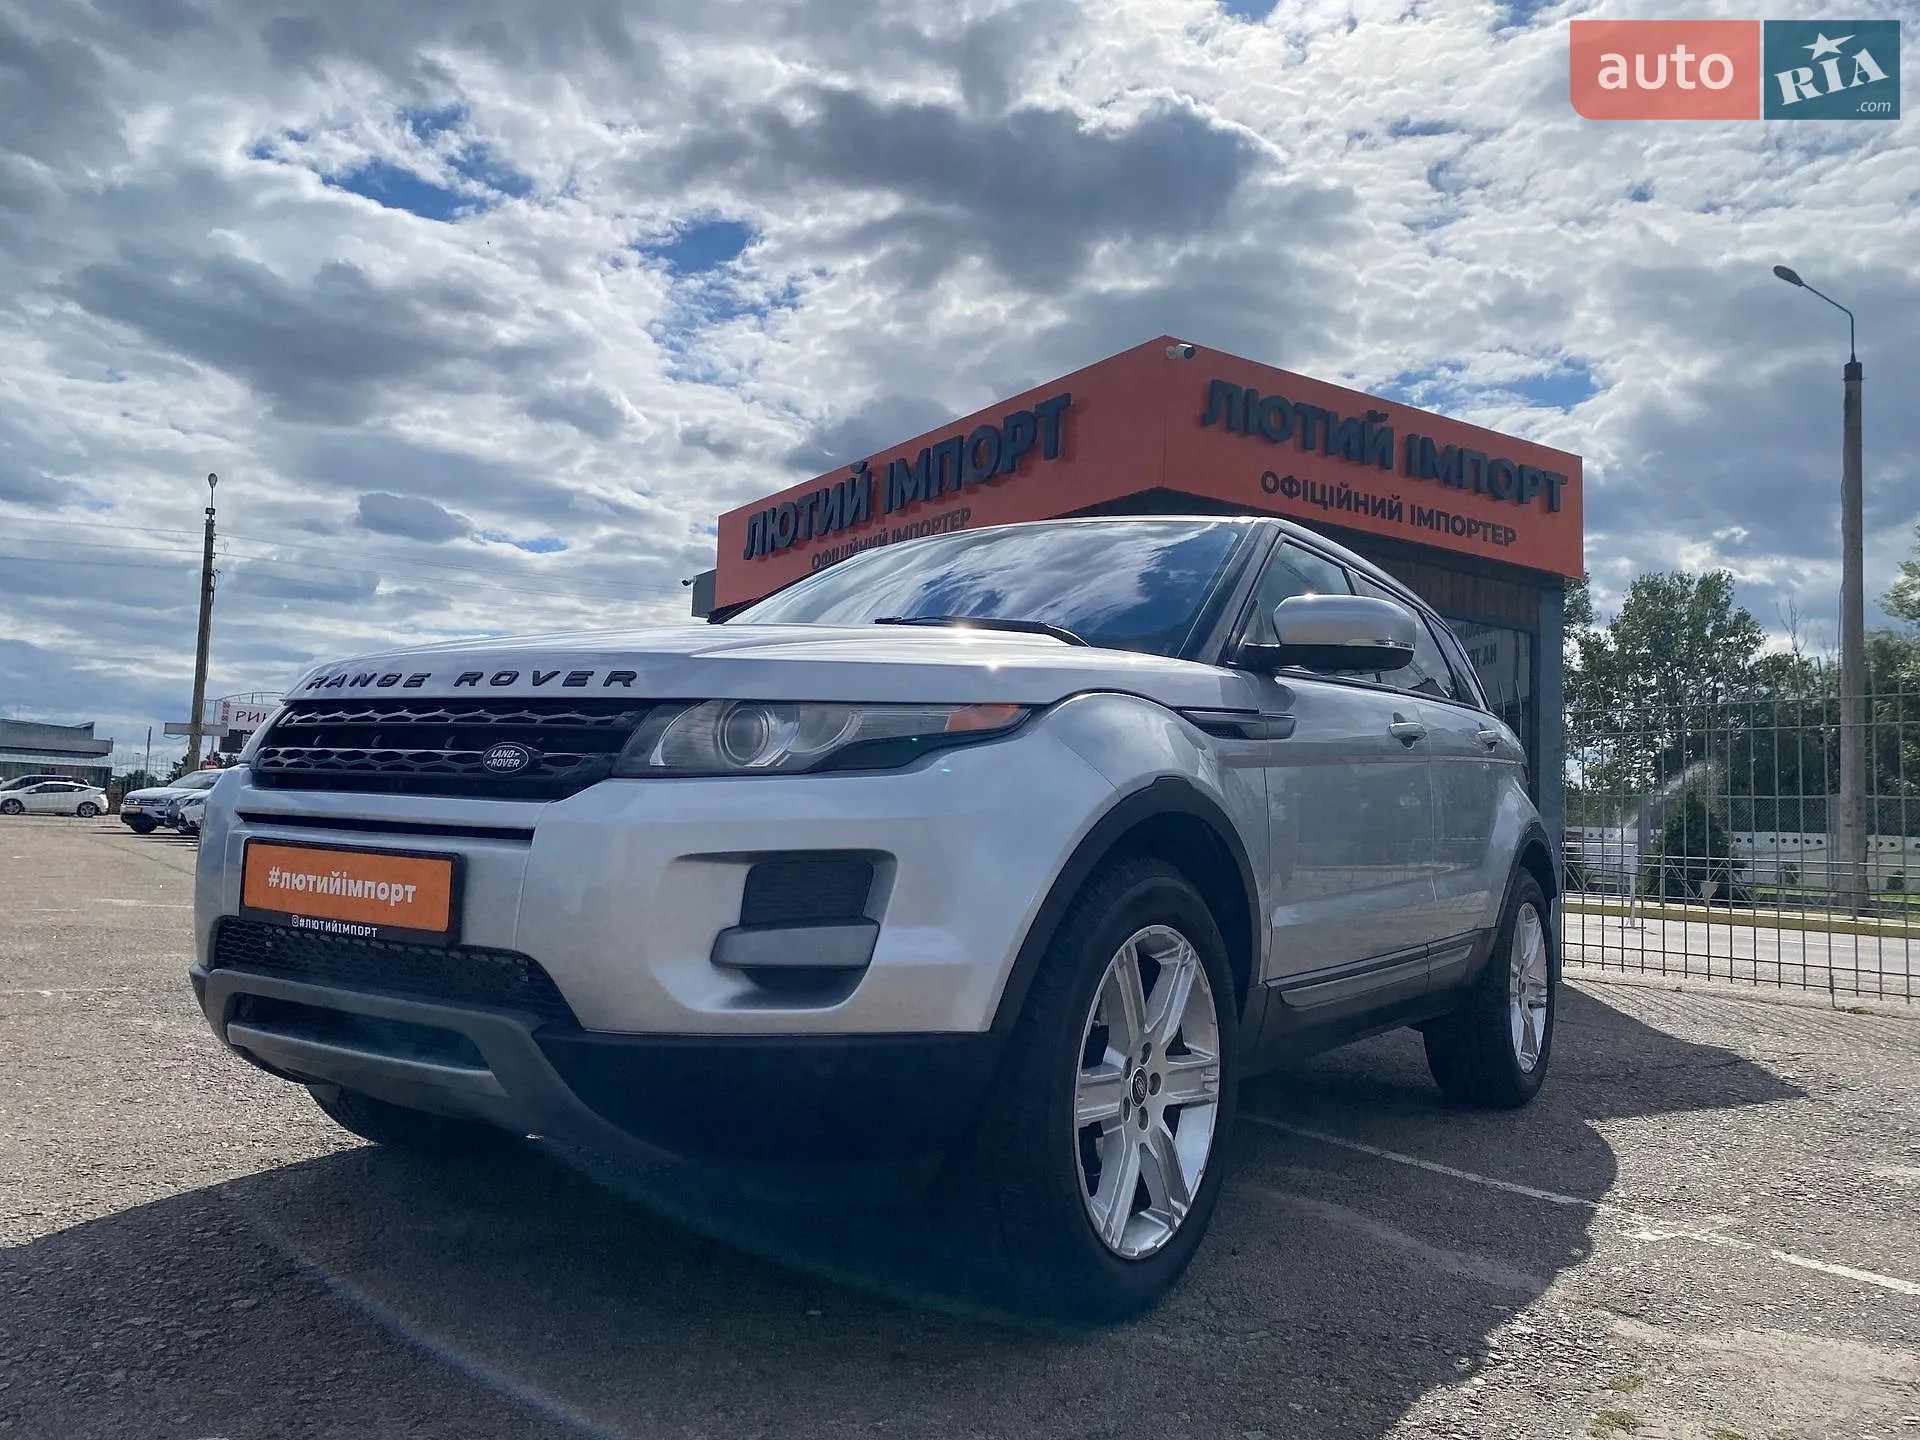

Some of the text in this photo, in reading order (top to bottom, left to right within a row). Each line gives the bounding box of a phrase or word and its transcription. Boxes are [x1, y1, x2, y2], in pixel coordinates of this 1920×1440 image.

[743, 393, 1072, 560] ЛЮТИЙ ІМПОРТ
[1202, 379, 1568, 513] ЛЮТИЙ ІМПОРТ
[1261, 470, 1517, 546] ОФІЦІЙНИЙ ІМПОРТЕР
[305, 670, 638, 690] RANGE ROVER
[268, 866, 416, 907] #лютийімпорт
